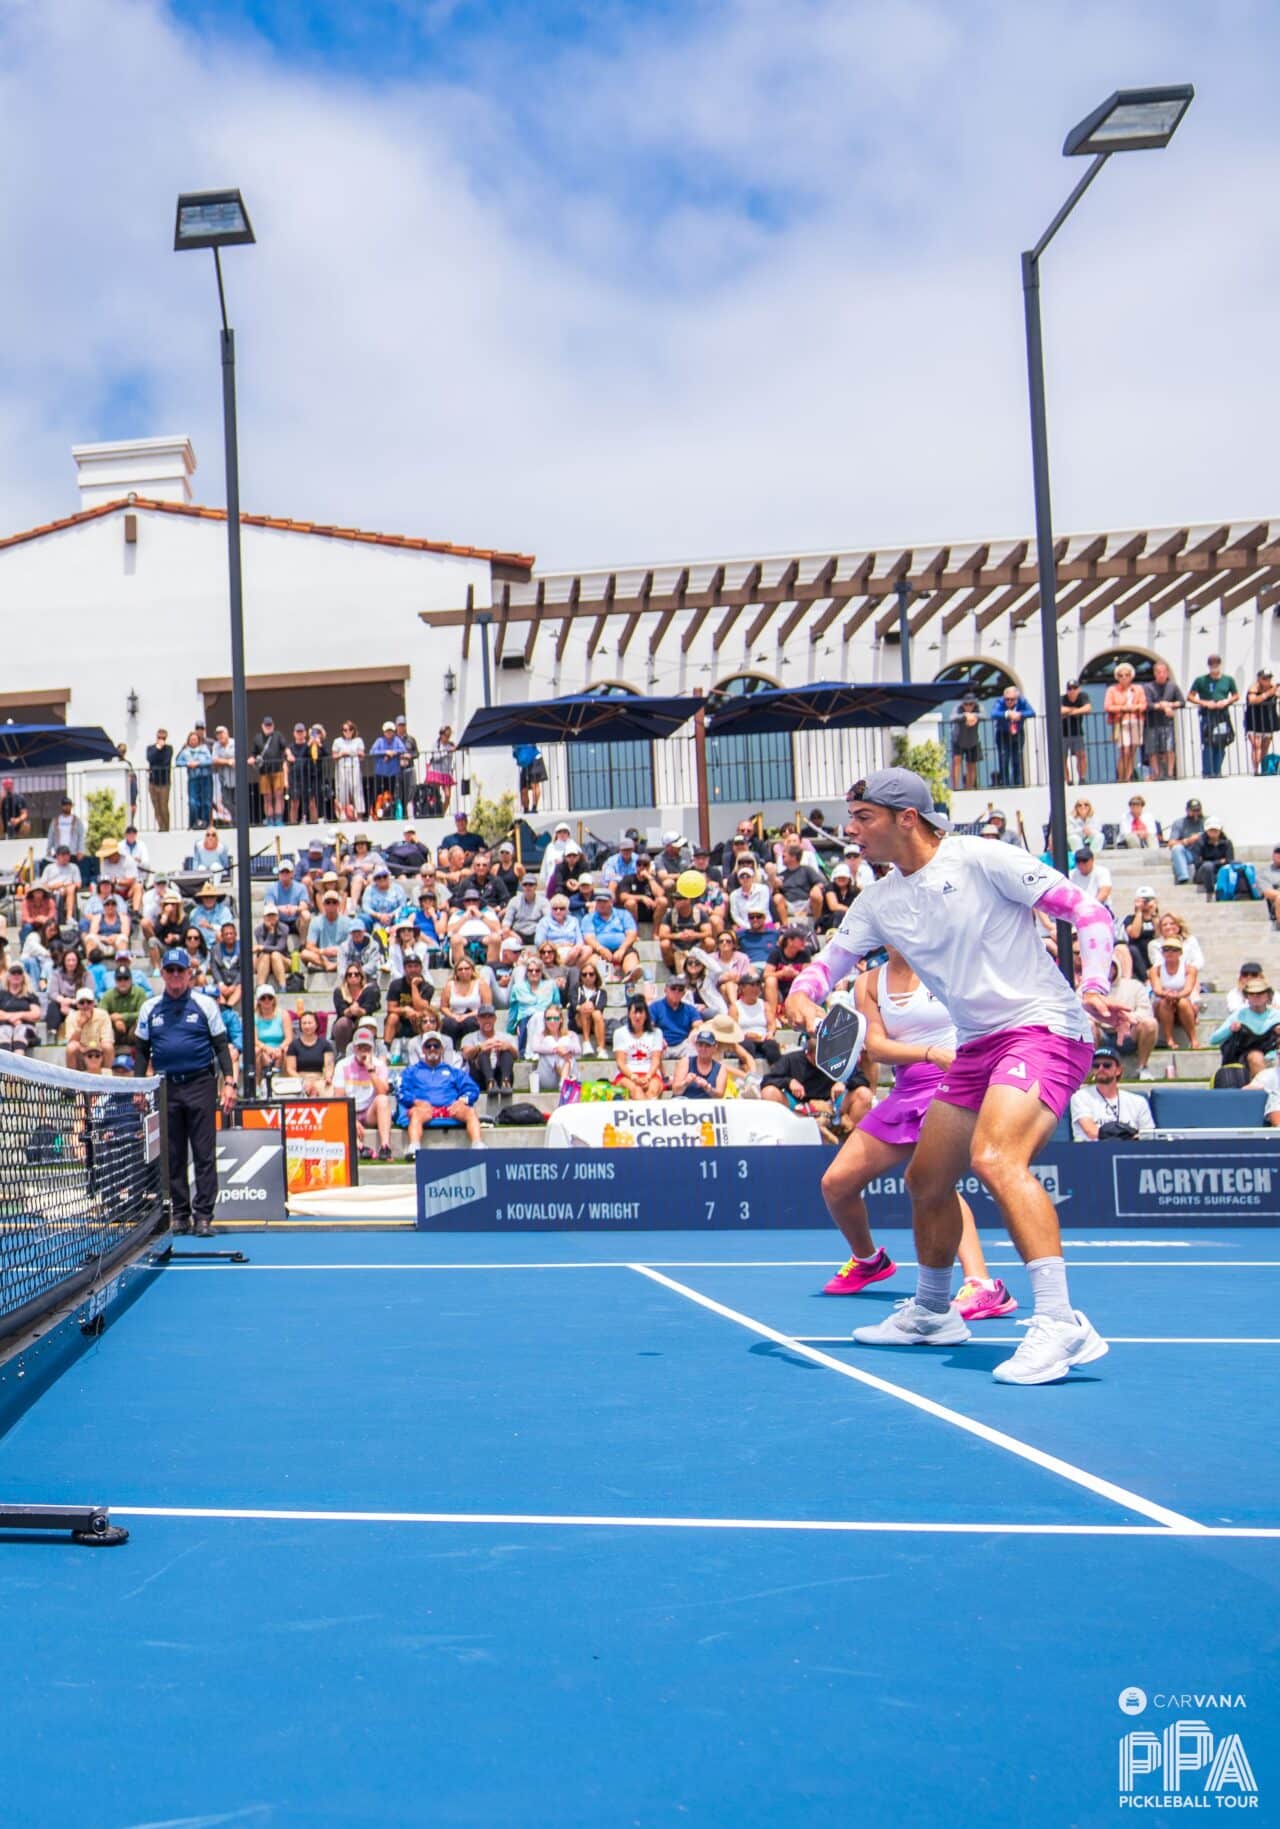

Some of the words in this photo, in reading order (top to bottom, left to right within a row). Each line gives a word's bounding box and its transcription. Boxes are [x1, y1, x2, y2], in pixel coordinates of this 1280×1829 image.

[613, 1105, 727, 1127] Pickleball
[636, 1127, 721, 1147] Centrl
[505, 1164, 558, 1180] WATERS
[573, 1163, 615, 1180] JOHNS
[700, 1162, 717, 1178] 11
[738, 1161, 748, 1177] 3
[1139, 1168, 1271, 1194] ACRYTECH
[429, 1185, 475, 1198] BAIRD
[1158, 1196, 1200, 1205] SPORTS
[1204, 1195, 1261, 1205] SURFACES
[507, 1203, 573, 1220] KOVALOVA
[589, 1202, 640, 1219] WRIGHT
[705, 1202, 715, 1219] 7
[740, 1202, 750, 1219] 3
